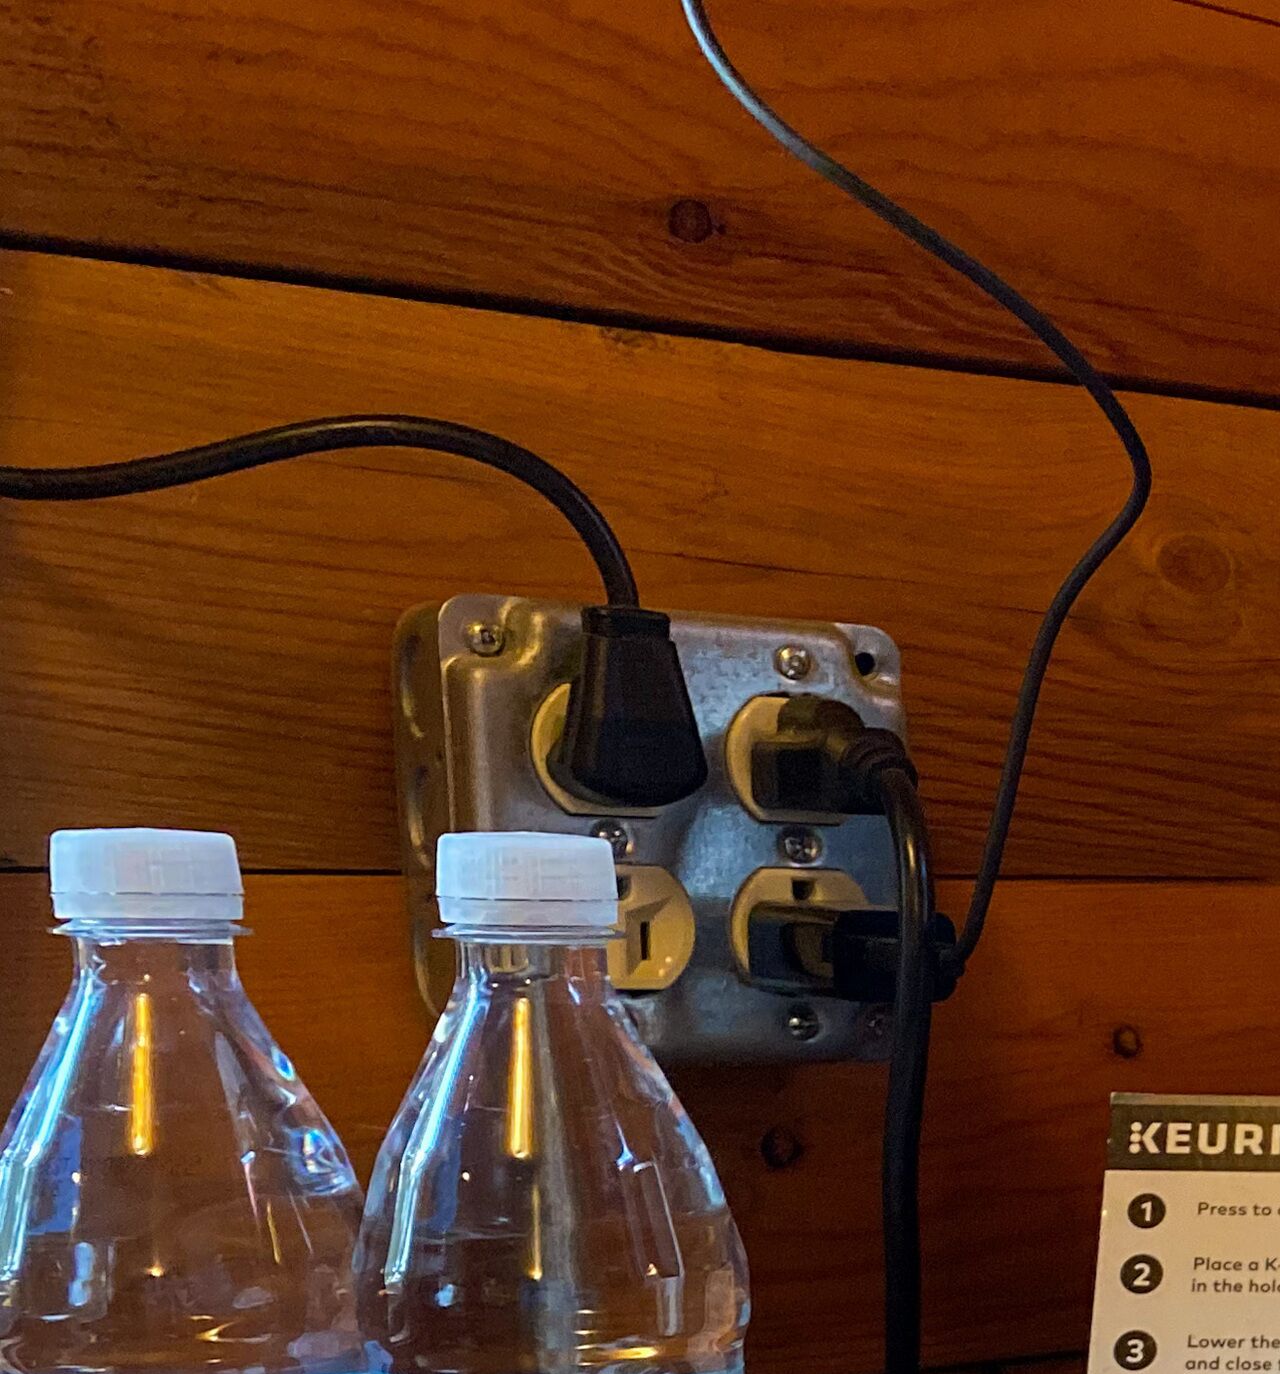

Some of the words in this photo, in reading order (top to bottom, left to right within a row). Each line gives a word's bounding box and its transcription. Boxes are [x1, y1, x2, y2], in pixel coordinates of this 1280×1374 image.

[1197, 1202, 1247, 1216] Press
[1253, 1203, 1272, 1216] to
[1193, 1256, 1243, 1272] Place
[1248, 1260, 1259, 1272] a
[1191, 1279, 1209, 1294] in
[1214, 1279, 1243, 1294] the
[1187, 1334, 1246, 1349] Lower
[1251, 1335, 1280, 1349] the
[1185, 1357, 1220, 1371] and
[1225, 1357, 1272, 1371] close
